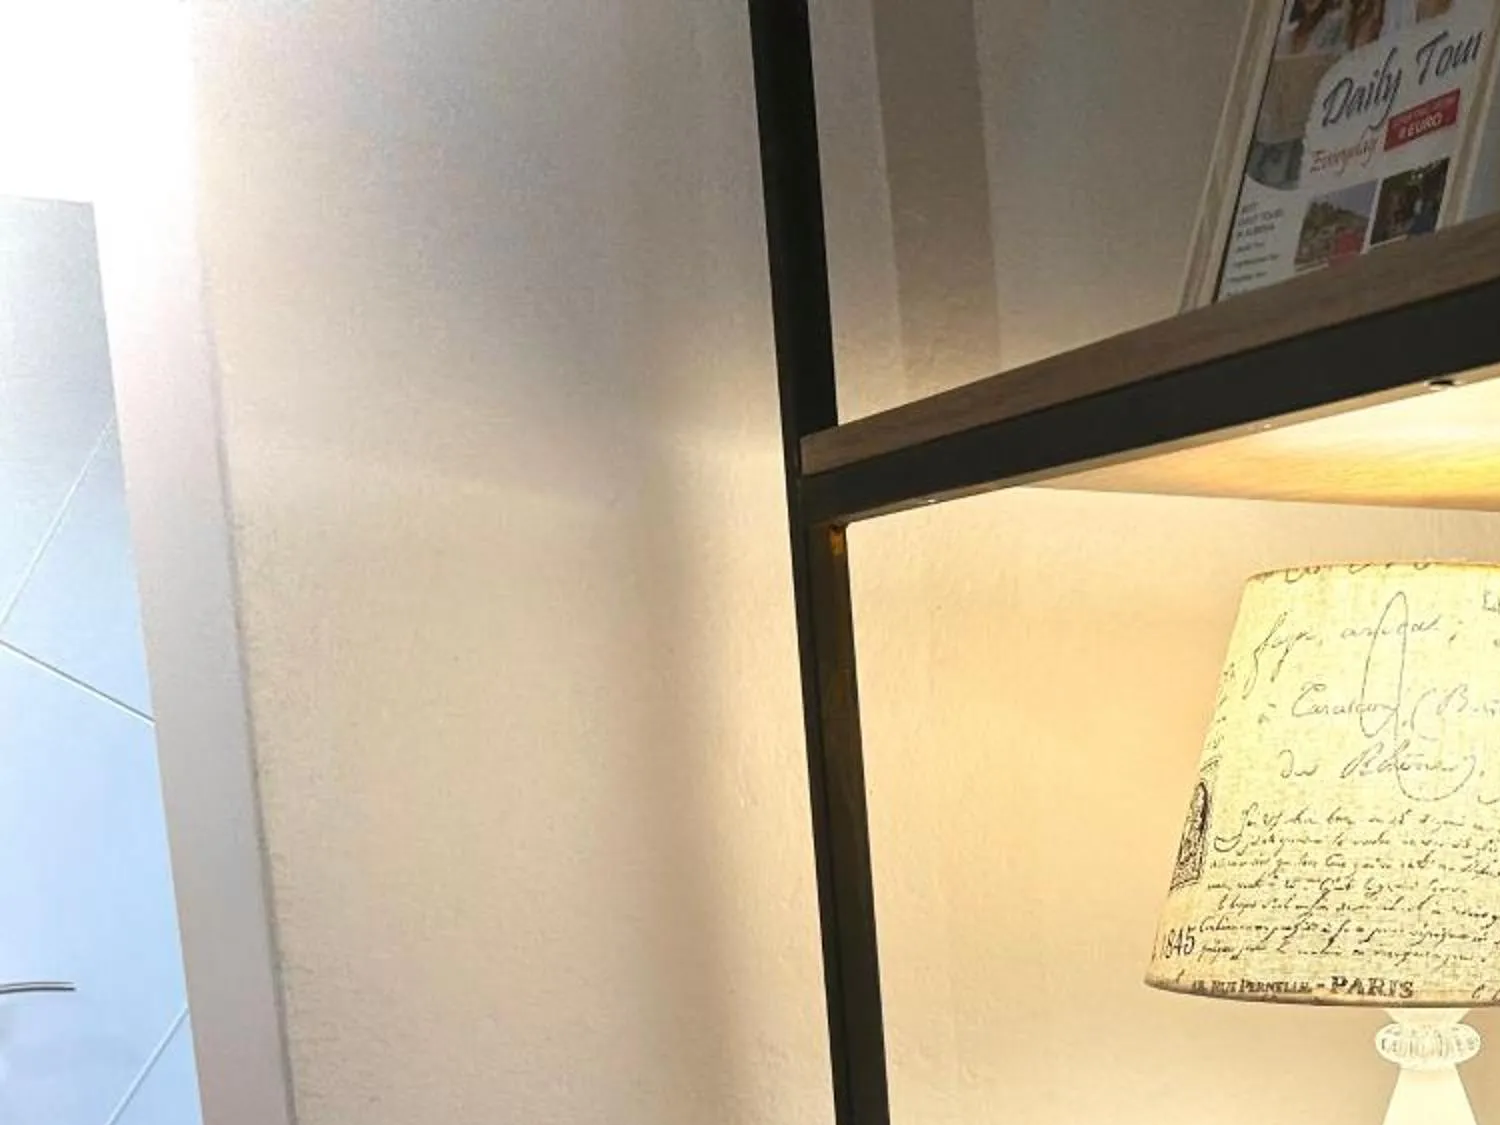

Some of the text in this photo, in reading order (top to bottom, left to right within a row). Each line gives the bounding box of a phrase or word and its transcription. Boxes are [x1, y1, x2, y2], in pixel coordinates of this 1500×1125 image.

[1321, 46, 1402, 131] Daily
[1416, 30, 1485, 85] Tour
[1329, 975, 1414, 999] PARIS
